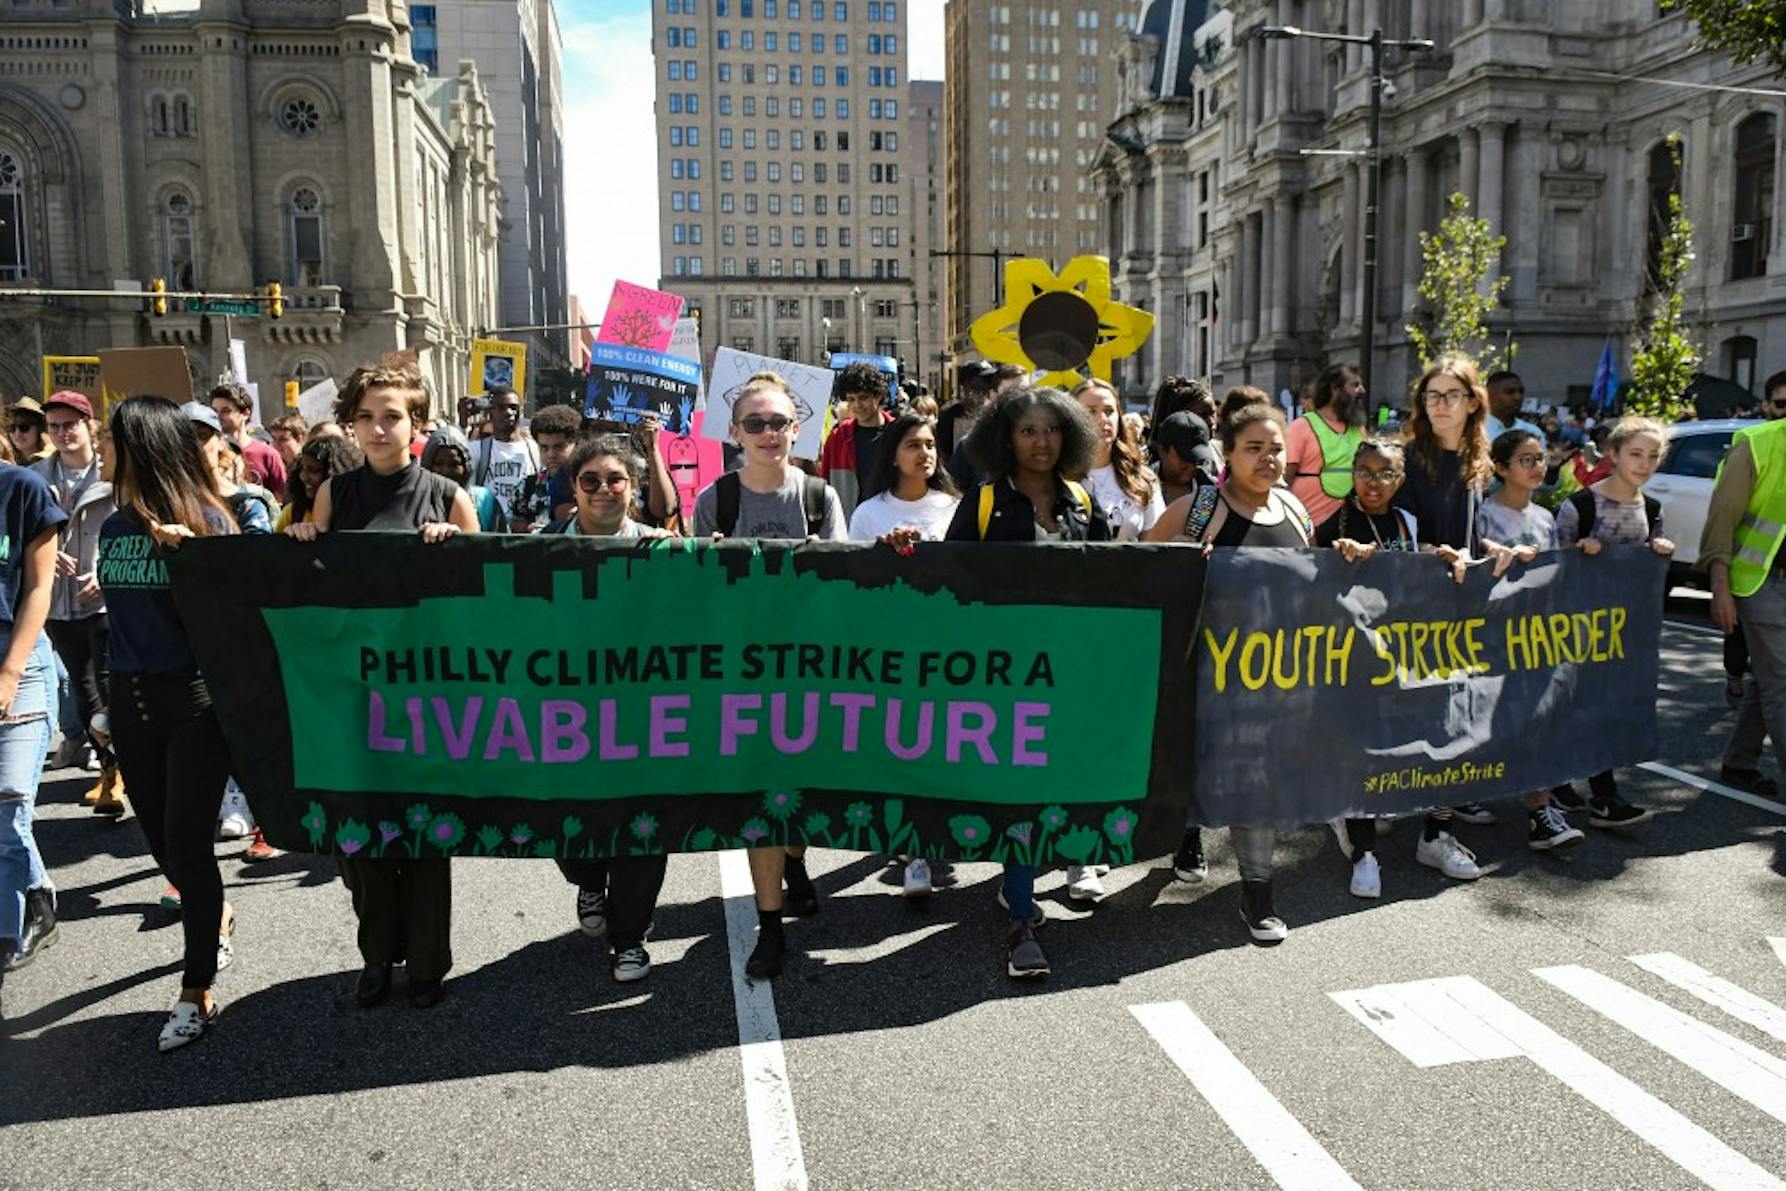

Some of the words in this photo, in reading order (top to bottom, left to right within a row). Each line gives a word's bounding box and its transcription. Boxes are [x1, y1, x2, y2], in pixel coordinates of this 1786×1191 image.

[627, 287, 682, 313] GREEN
[597, 347, 623, 360] 100%
[625, 351, 660, 367] CLEAN
[661, 358, 698, 376] ENERGY
[734, 355, 819, 387] PLANET
[54, 375, 82, 388] KEEP
[84, 376, 96, 388] IT
[604, 370, 630, 383] 100%
[632, 374, 658, 388] HERE
[659, 378, 676, 392] FOR
[677, 384, 688, 395] IT
[109, 534, 153, 559] GREEN
[1204, 625, 1355, 693] YOUTH
[1370, 618, 1491, 687] STRIKE
[1505, 607, 1627, 671] HARDER
[360, 645, 513, 685] PHILLY
[526, 644, 724, 687] CLIMATE
[740, 643, 905, 685] STRIKE
[918, 649, 1013, 688] FOR
[1023, 651, 1055, 687] A
[367, 689, 692, 764] LIVABLE
[719, 691, 1051, 767] FUTURE
[1364, 760, 1505, 795] #PAClimateStrike
